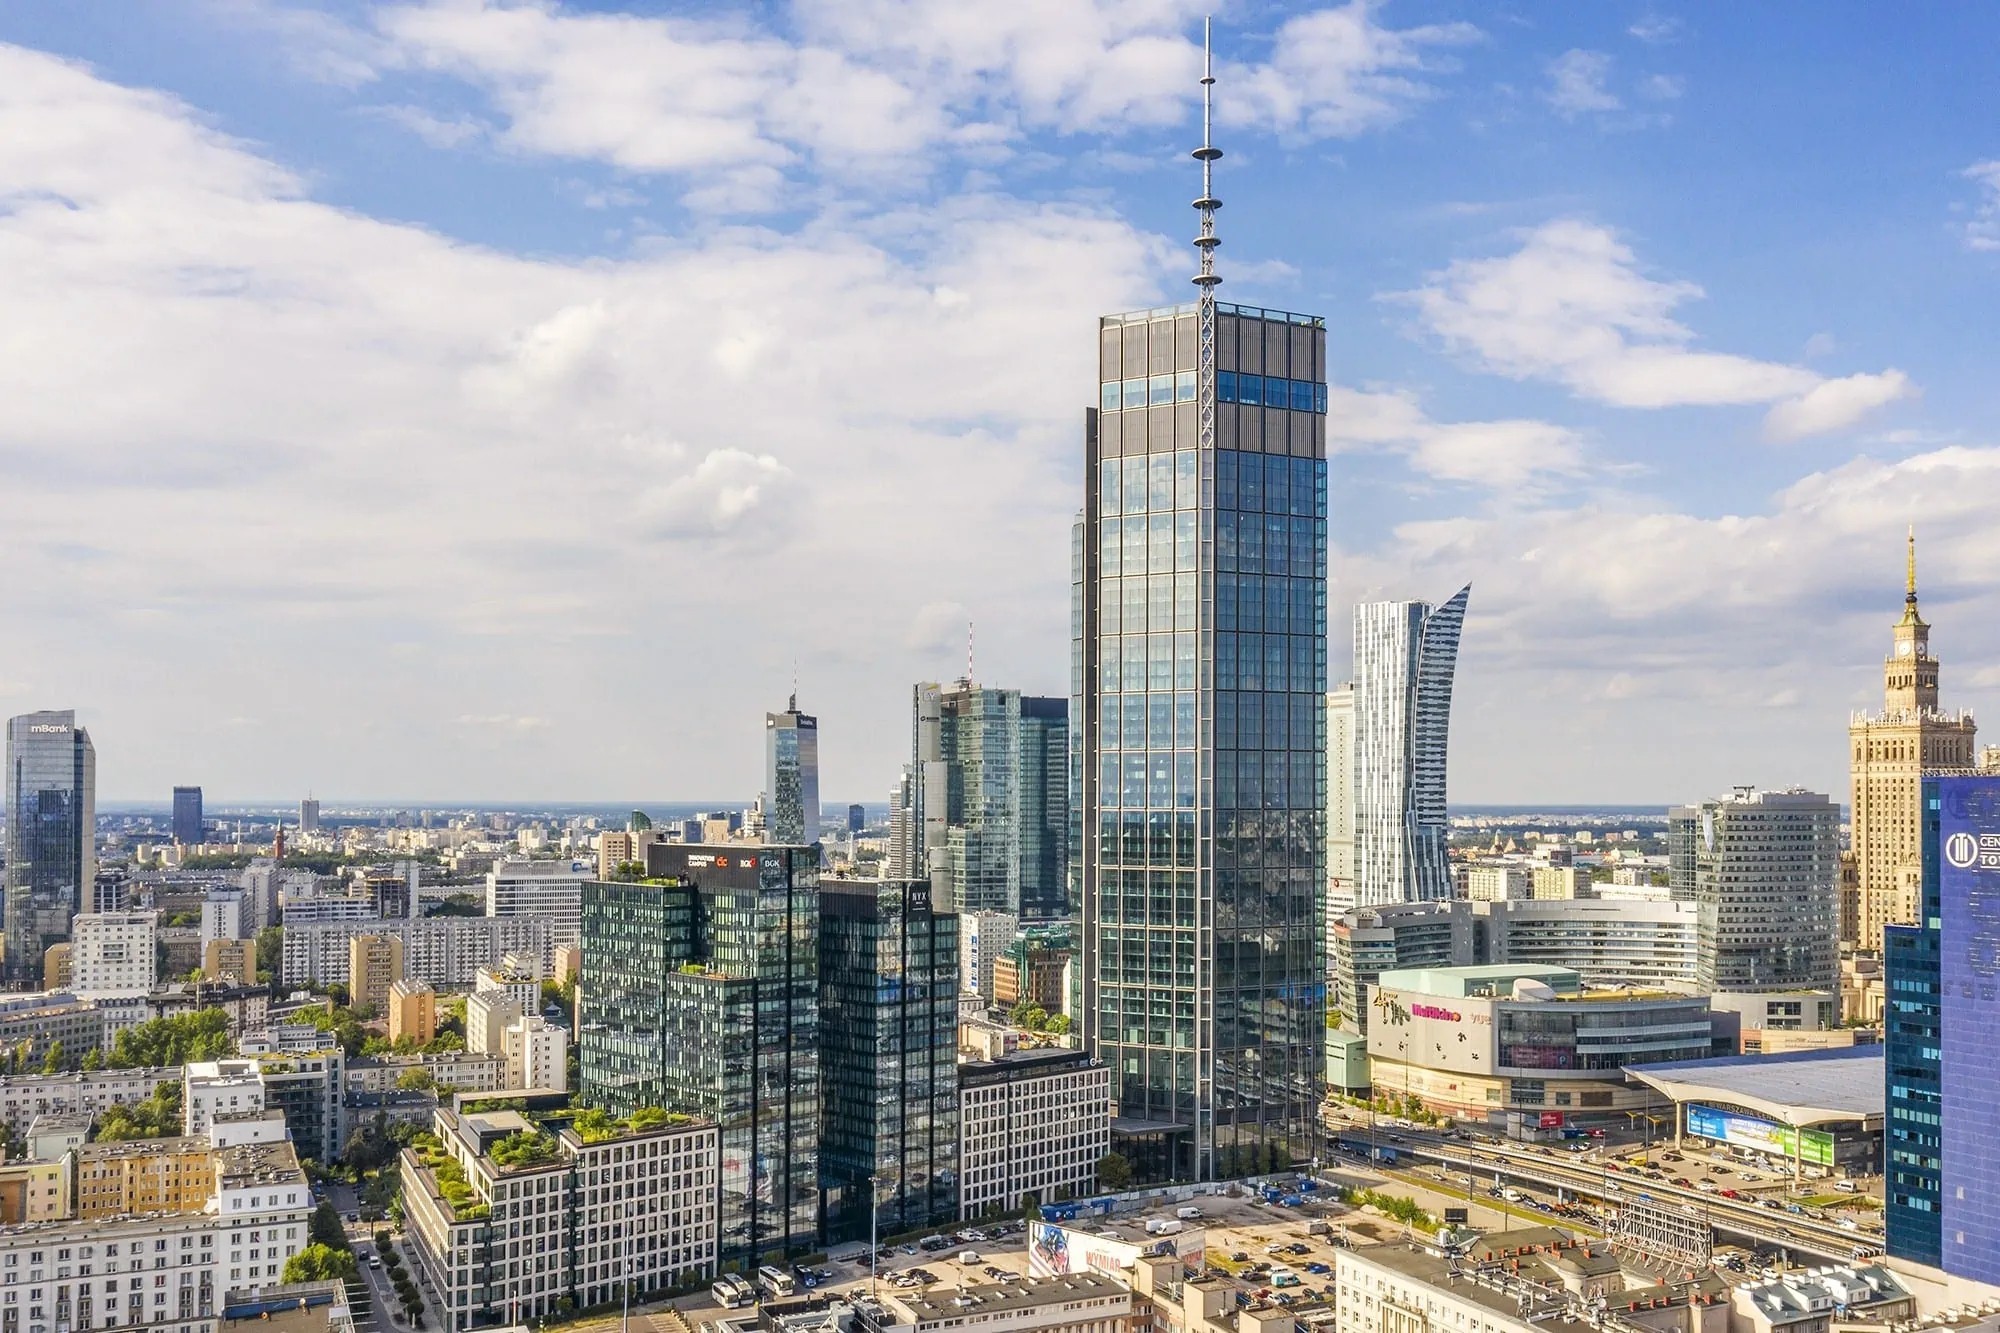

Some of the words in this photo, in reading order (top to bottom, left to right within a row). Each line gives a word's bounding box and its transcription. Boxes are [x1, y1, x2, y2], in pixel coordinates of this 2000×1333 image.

[31, 724, 69, 733] mBank
[764, 859, 780, 868] BGK
[1980, 855, 2000, 865] TO
[912, 892, 927, 901] NYX
[1715, 1101, 1754, 1117] WARSZAWA
[1085, 1250, 1121, 1273] WYMIAR
